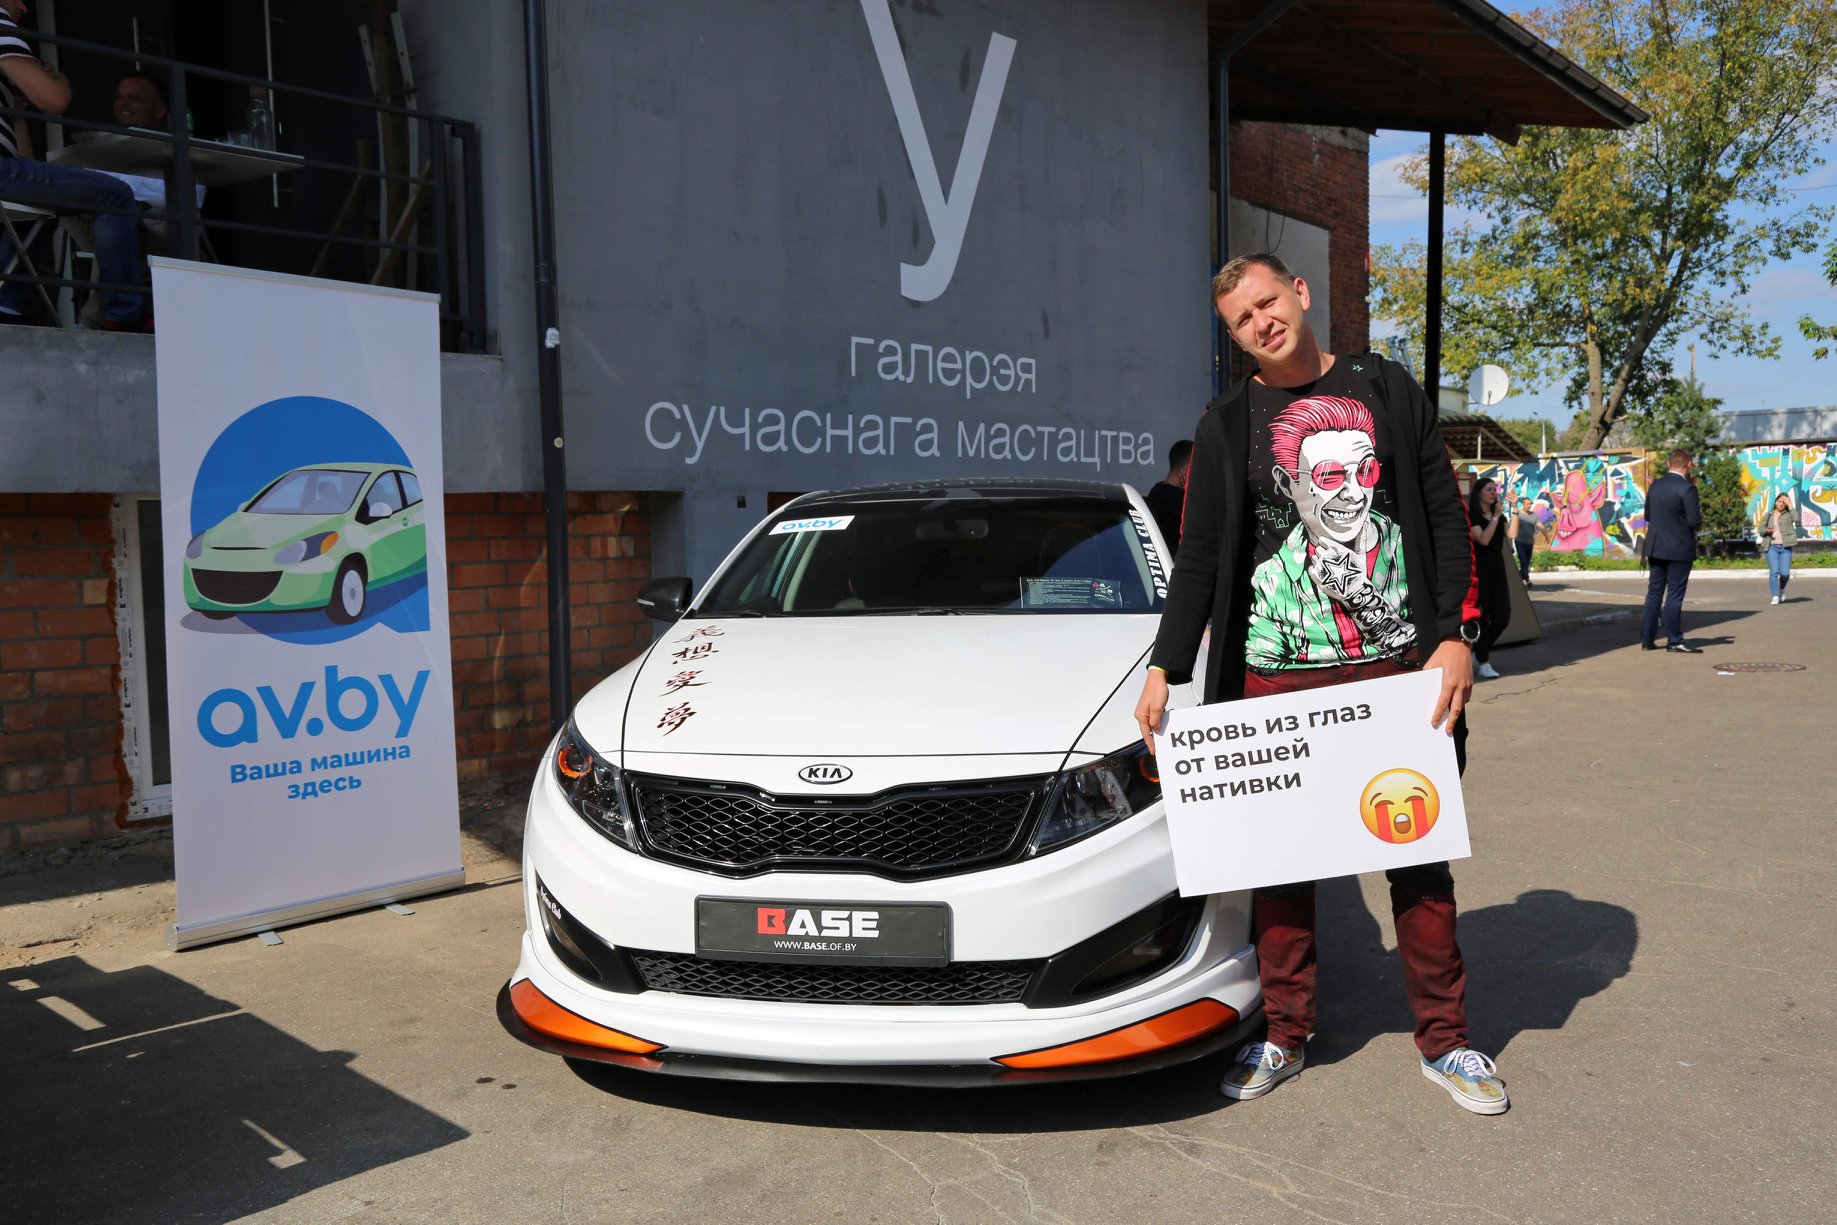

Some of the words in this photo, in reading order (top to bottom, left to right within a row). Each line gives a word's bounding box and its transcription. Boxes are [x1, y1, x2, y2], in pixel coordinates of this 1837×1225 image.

[850, 335, 1037, 399] галерэя
[644, 401, 941, 465] сучаснага
[956, 420, 1156, 470] мастацтва
[782, 519, 842, 531] av.by
[1142, 543, 1168, 599] OPTIMA
[197, 664, 431, 749] av.by
[1170, 718, 1257, 750] кровь
[1265, 713, 1300, 735] из
[1308, 702, 1373, 728] глаз
[230, 756, 303, 784] Ваша
[310, 743, 411, 772] машина
[807, 767, 843, 780] KIA
[1174, 756, 1205, 776] от
[1213, 736, 1311, 771] вашей
[287, 774, 362, 800] здесь
[1180, 771, 1302, 804] нативки
[757, 907, 880, 938] BASE
[773, 940, 857, 952] WWW.BASE.OF.BY
